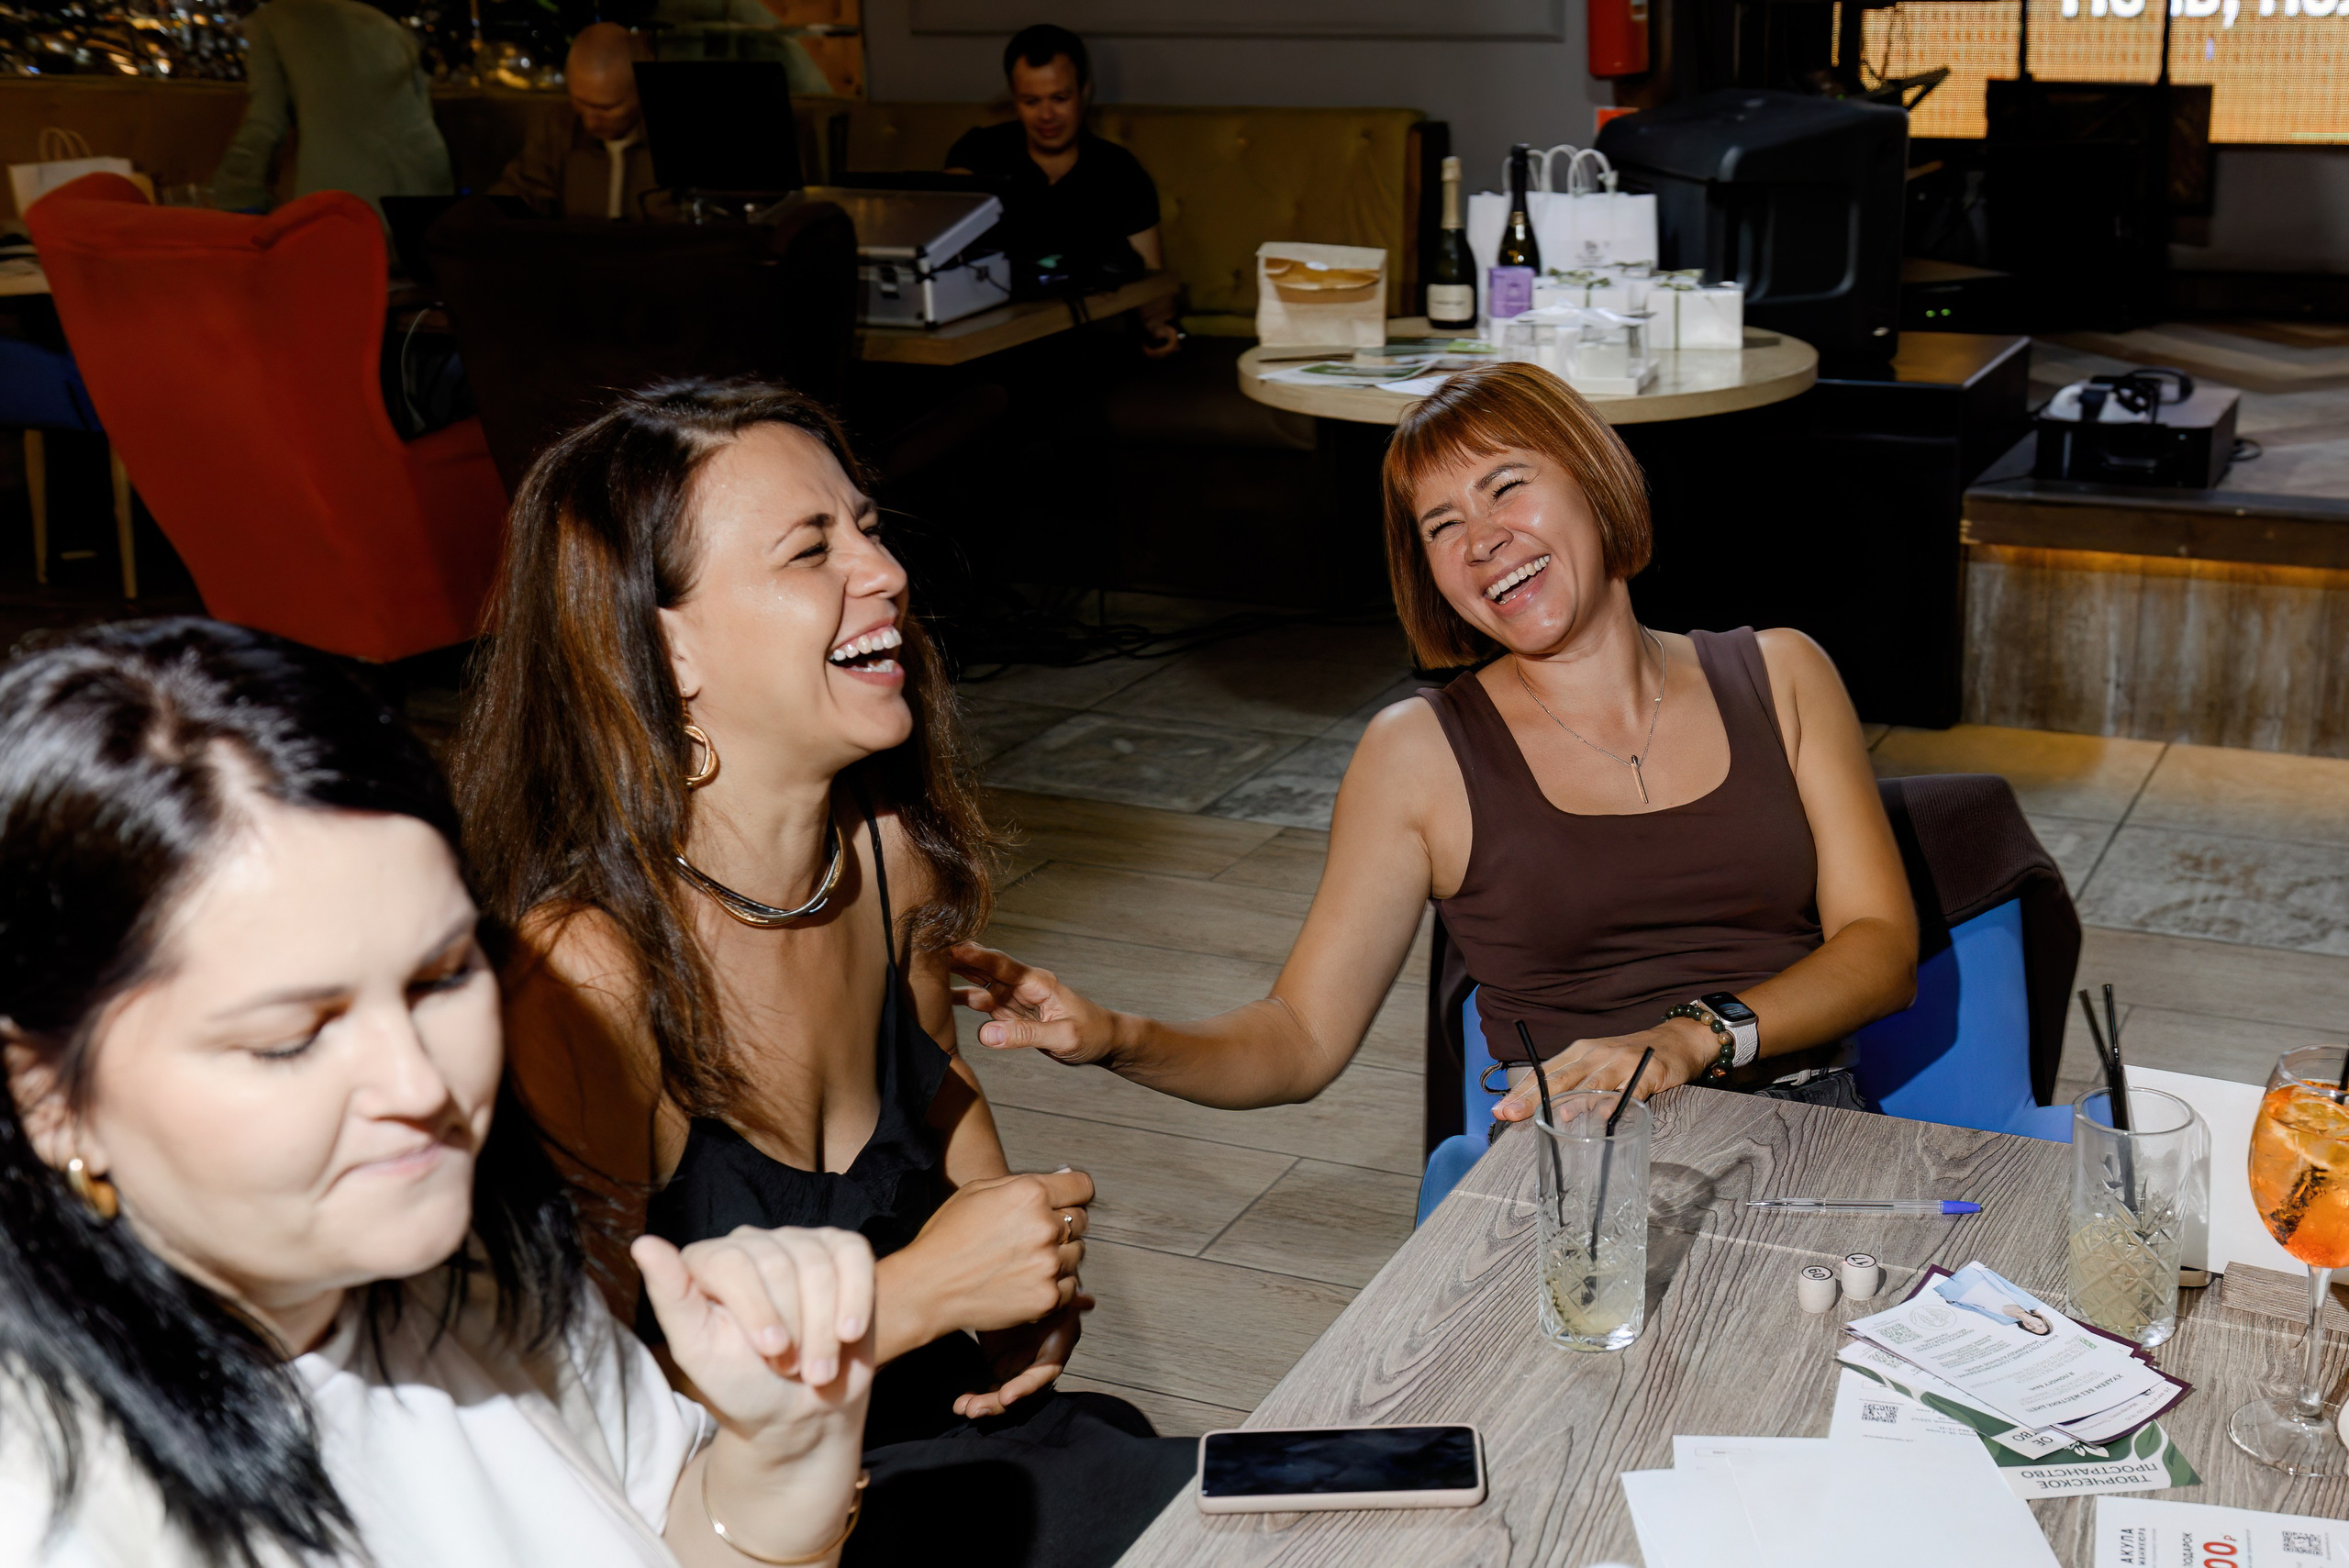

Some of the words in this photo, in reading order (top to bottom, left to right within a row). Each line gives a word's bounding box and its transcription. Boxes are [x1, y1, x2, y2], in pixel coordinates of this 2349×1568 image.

[1851, 1257, 1869, 1265] 17
[2021, 1463, 2159, 1479] ПРОСТРАНСТВО
[2036, 1474, 2152, 1489] ТВОРЧЕСКОЕ
[2121, 1528, 2134, 1564] АКУЛА
